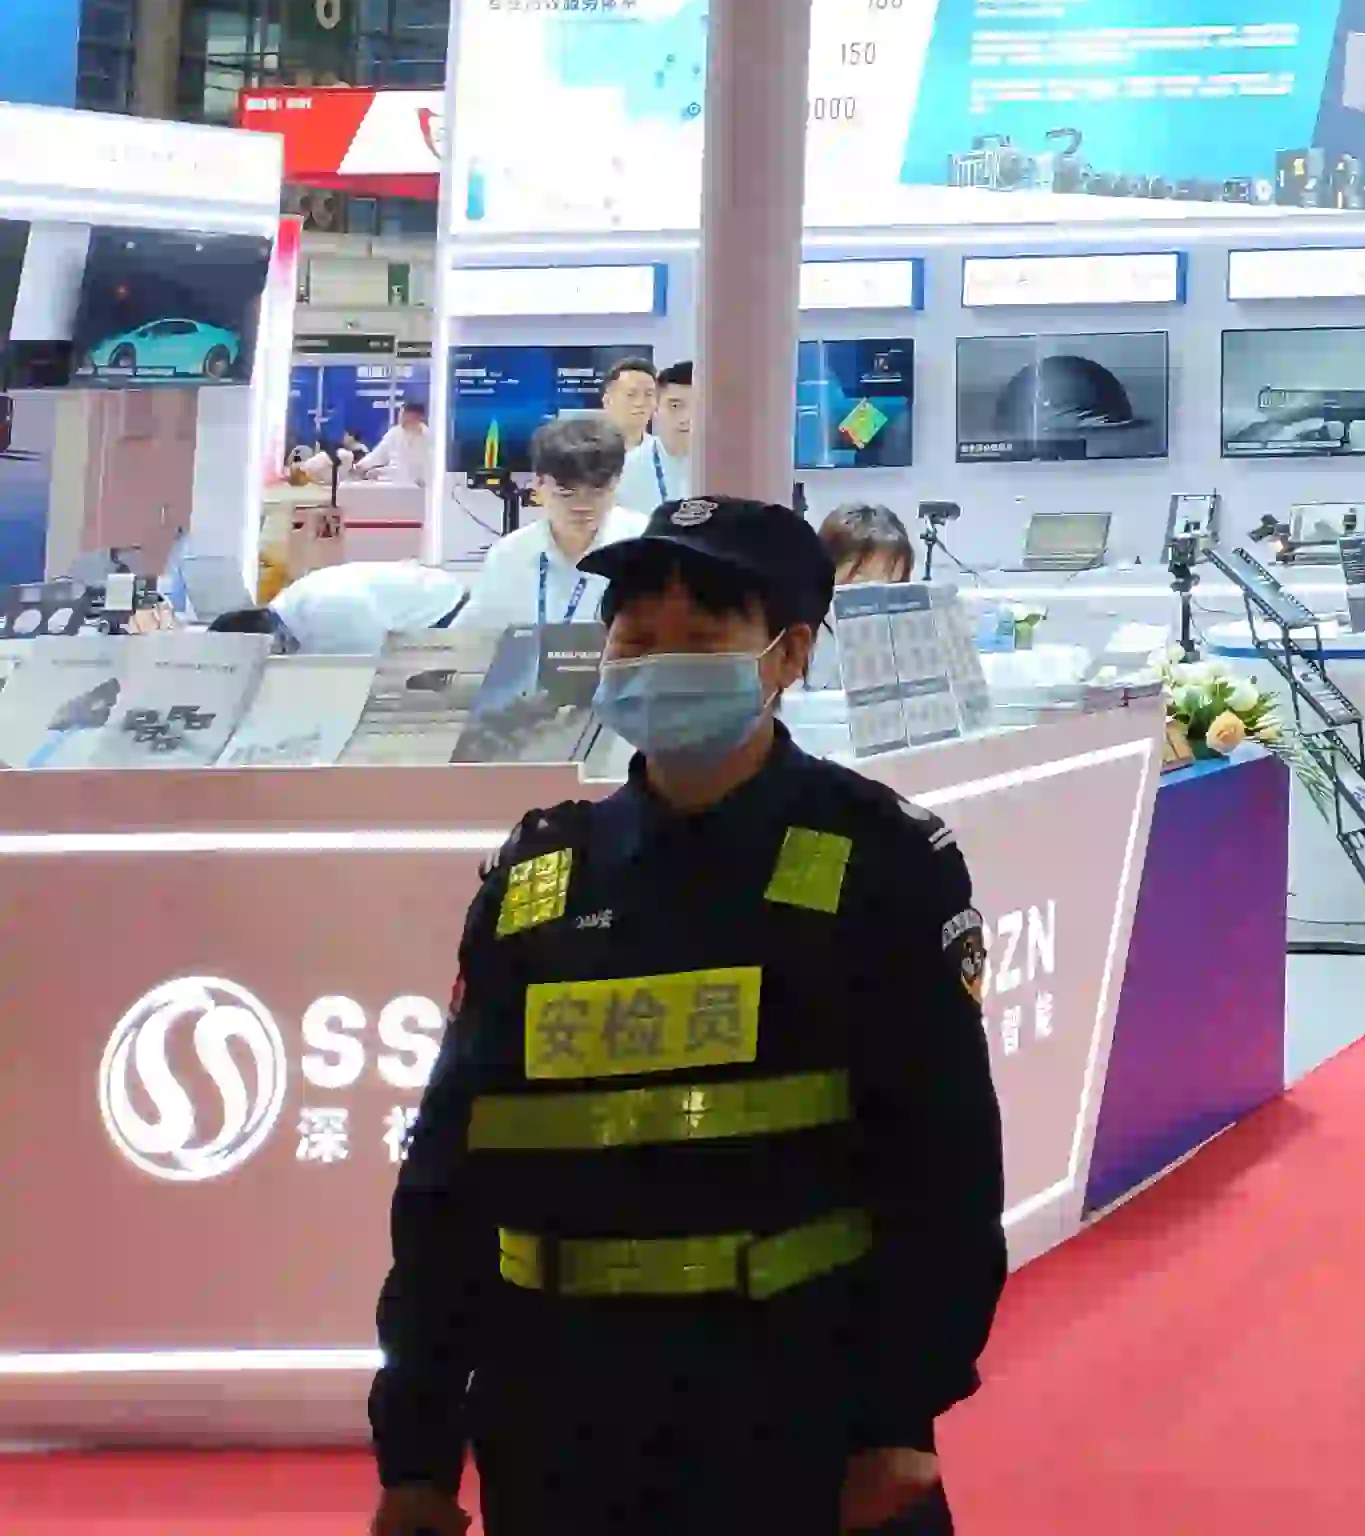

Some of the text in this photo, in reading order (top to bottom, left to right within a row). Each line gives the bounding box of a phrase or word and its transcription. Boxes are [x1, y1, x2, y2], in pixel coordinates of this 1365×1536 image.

[841, 41, 876, 65] 150
[535, 984, 743, 1064] 安检员
